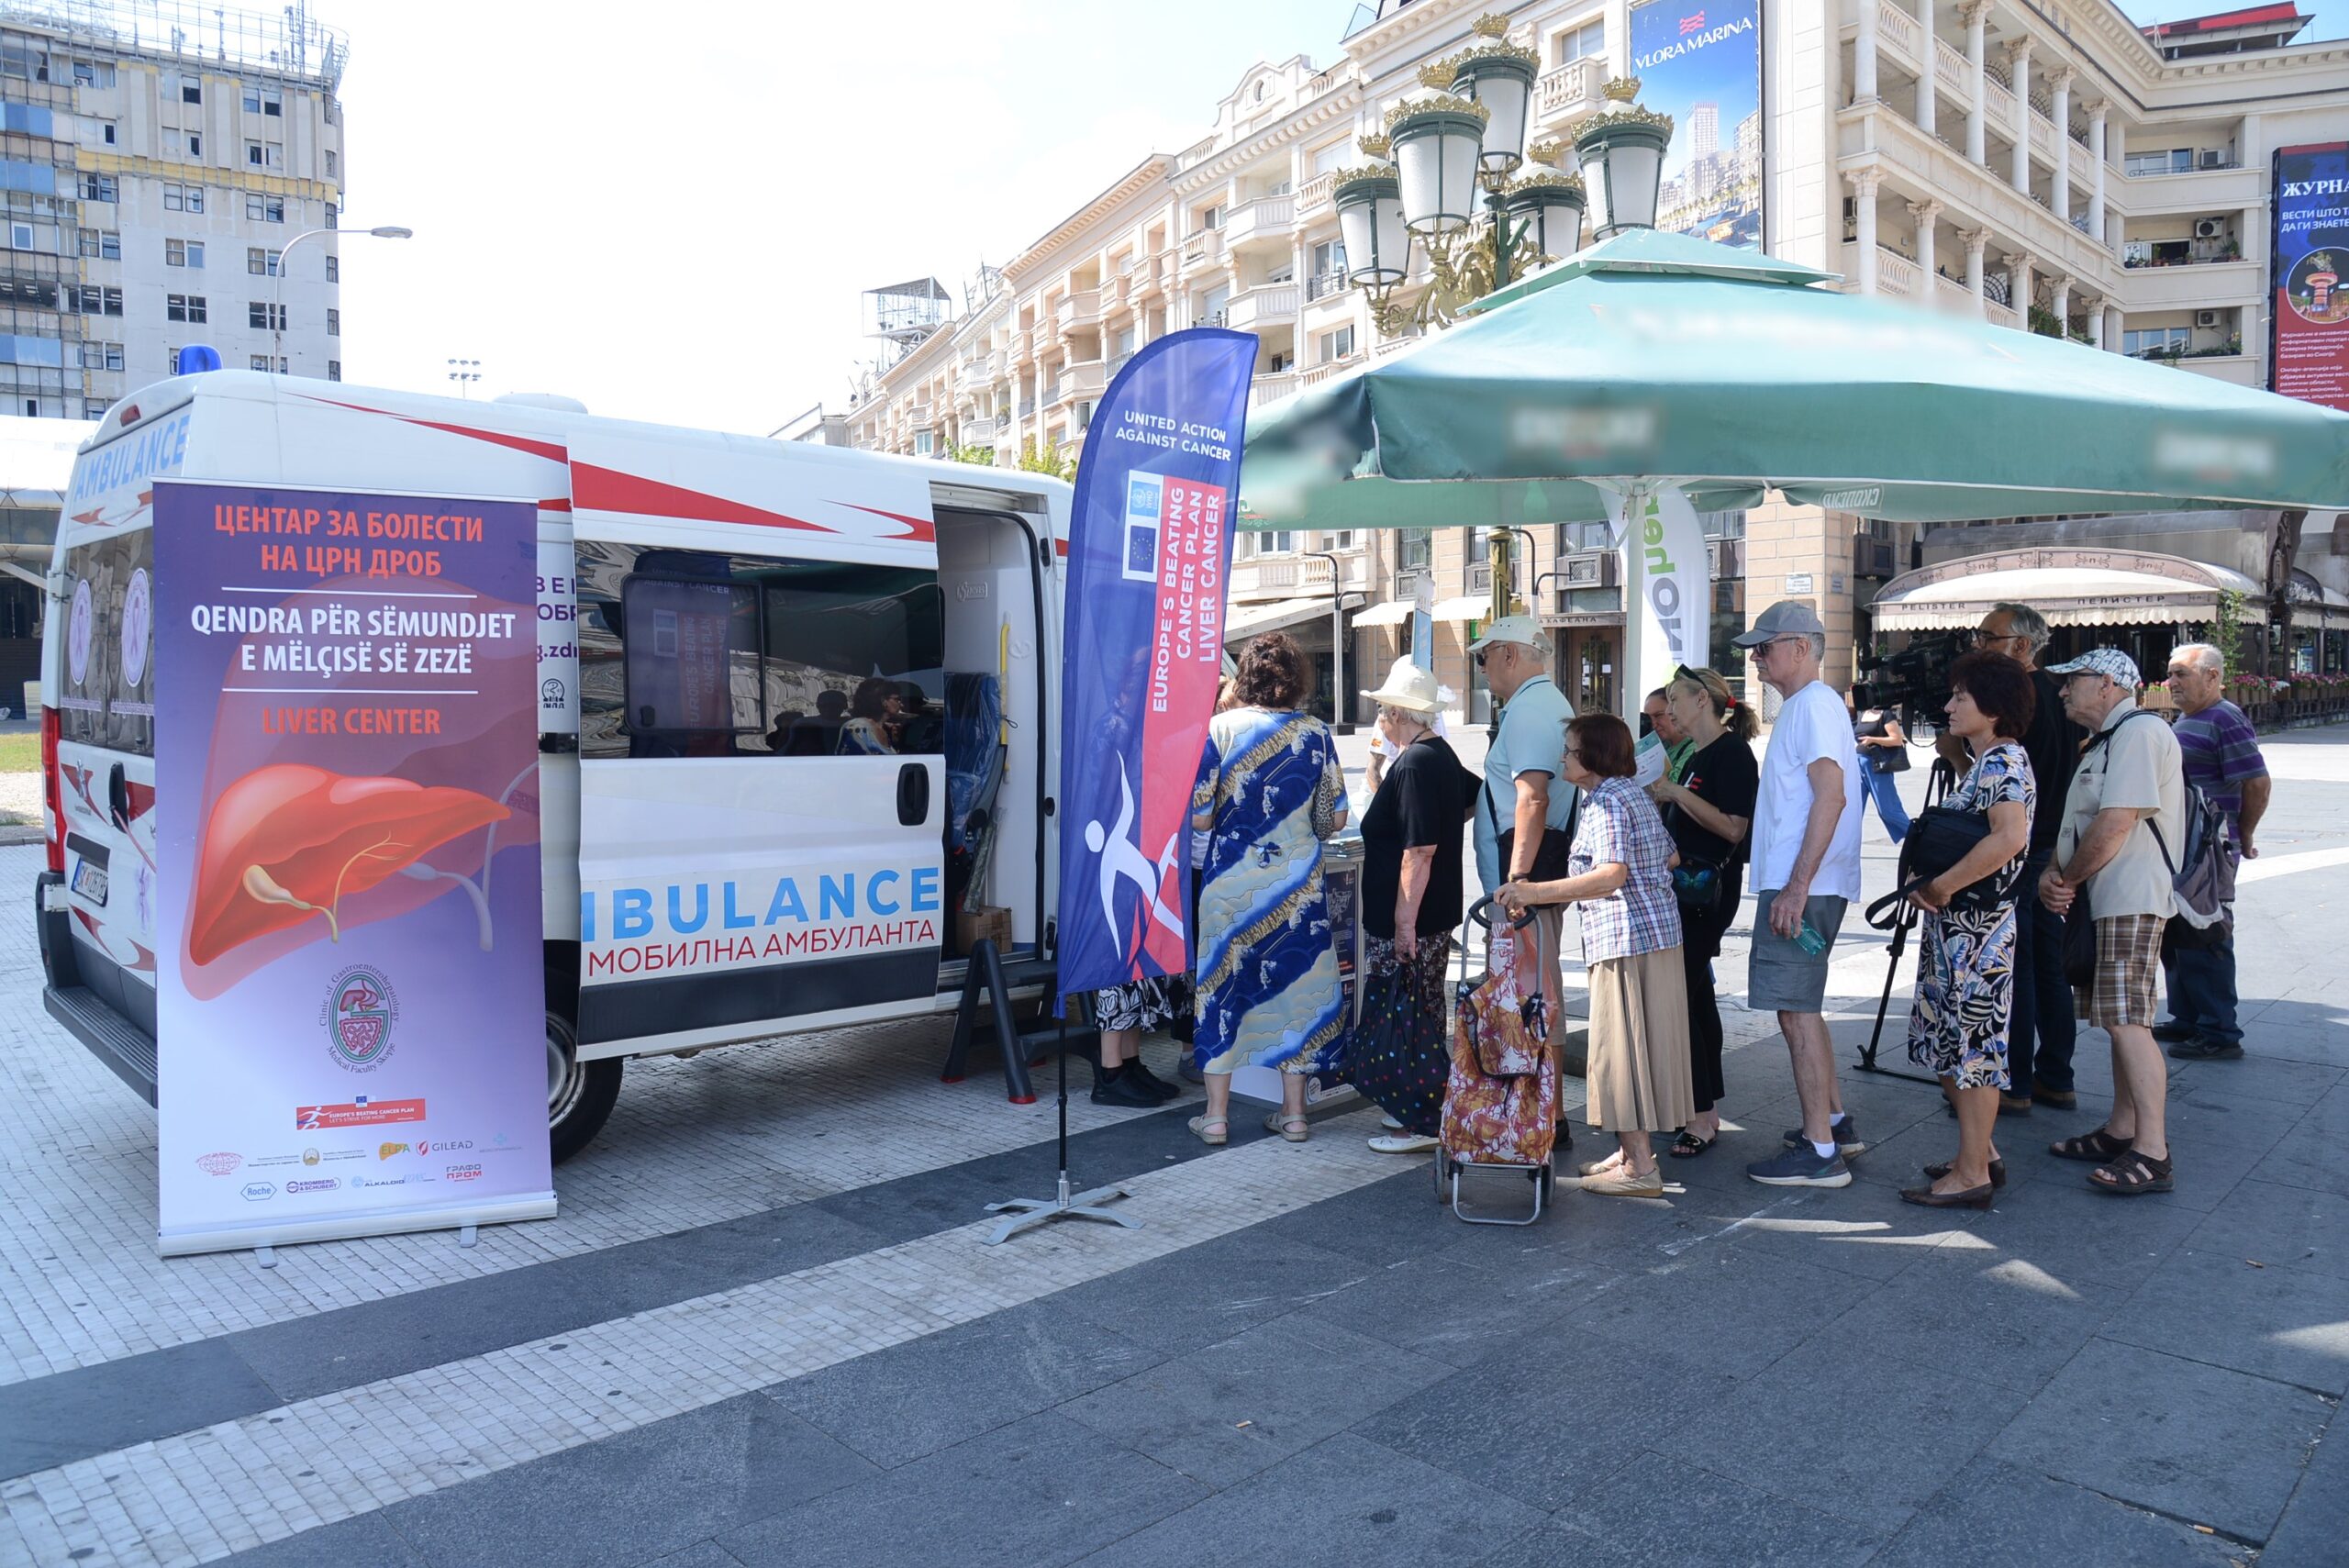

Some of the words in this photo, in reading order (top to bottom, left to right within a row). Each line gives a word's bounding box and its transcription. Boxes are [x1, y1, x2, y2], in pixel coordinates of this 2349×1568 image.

[1634, 42, 1686, 70] VLORA
[1687, 17, 1753, 52] MARINA
[2281, 222, 2297, 233] ДА
[2297, 221, 2311, 230] ГИ
[2282, 210, 2315, 220] ВЕСТИ
[2316, 207, 2342, 218] ШТО
[1124, 410, 1176, 431] UNITED
[1180, 421, 1227, 442] ACTION
[74, 414, 191, 502] AMBULANCE
[1115, 426, 1177, 450] AGAINST
[1181, 439, 1231, 462] CANCER
[215, 505, 320, 536] ЦЕНТАР
[327, 508, 362, 536] ЗА
[366, 513, 484, 542] БОЛЕСТИ
[1164, 487, 1185, 589] BEATING
[1185, 491, 1203, 555] PLAN
[1200, 495, 1219, 589] CANCER
[261, 545, 299, 571] НА
[306, 547, 362, 575] ЦРН
[369, 549, 441, 578] ДРОБ
[1176, 558, 1196, 660] CANCER
[1901, 602, 1965, 611] PELISTER
[2077, 595, 2165, 606] ПЕЛИСТЕР
[191, 605, 304, 639] QENDRA
[311, 603, 361, 636] PËR
[368, 605, 516, 639] SËMUNDJET
[1198, 595, 1217, 663] LIVER
[242, 644, 256, 671] E
[263, 639, 373, 679] MËLÇISË
[379, 641, 409, 673] SË
[415, 643, 473, 674] ZEZË
[262, 707, 337, 734] LIVER
[343, 707, 440, 734] CENTER
[588, 938, 756, 977] МОБИЛНА
[763, 919, 935, 959] АМБУЛАНТА
[318, 999, 329, 1027] Clinic
[326, 985, 334, 995] of
[326, 1045, 351, 1071] Medical
[351, 1062, 376, 1073] Faculty
[376, 1042, 396, 1066] Skopje
[431, 1140, 473, 1151] GILEAD
[364, 1179, 405, 1187] ALKALOID
[446, 1164, 482, 1173] ГРАФО
[447, 1171, 482, 1179] ПРОМ
[247, 1185, 272, 1196] Roche
